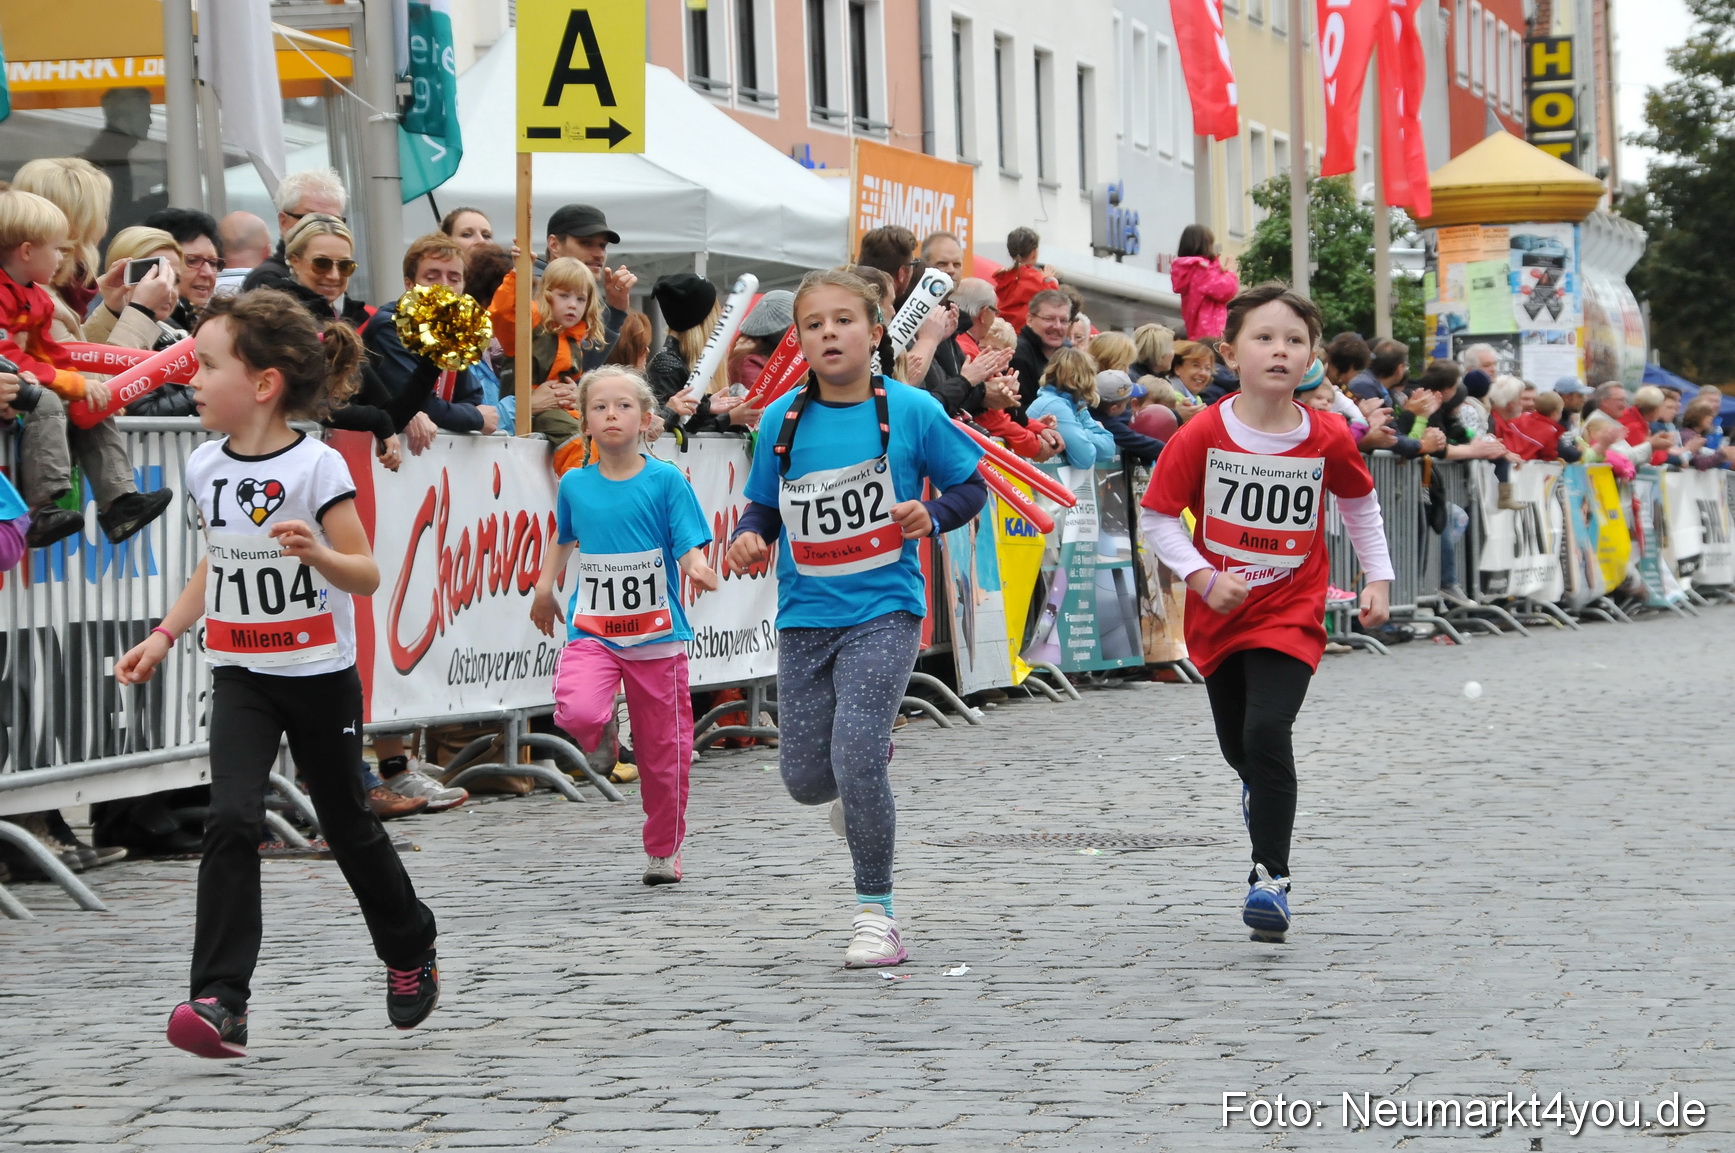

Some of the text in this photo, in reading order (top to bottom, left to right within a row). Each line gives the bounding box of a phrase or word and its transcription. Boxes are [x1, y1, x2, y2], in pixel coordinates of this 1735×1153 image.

[543, 8, 617, 107] A
[70, 351, 140, 367] udi BKK
[755, 351, 786, 396] Audi BKK
[781, 468, 871, 494] PARTL Neumarkt
[1209, 458, 1308, 480] PARTL Neumarkt
[210, 478, 229, 527] I
[790, 480, 890, 536] 7592
[1218, 476, 1315, 526] 7009
[1239, 531, 1279, 551] Anna
[580, 561, 651, 573] PARTL Neumarkt
[1244, 567, 1275, 581] DEHN
[212, 562, 318, 616] 7104
[585, 572, 657, 611] 7181
[231, 629, 295, 649] Milena
[604, 618, 640, 634] Heidi
[448, 640, 568, 689] Ostbayerns Ra
